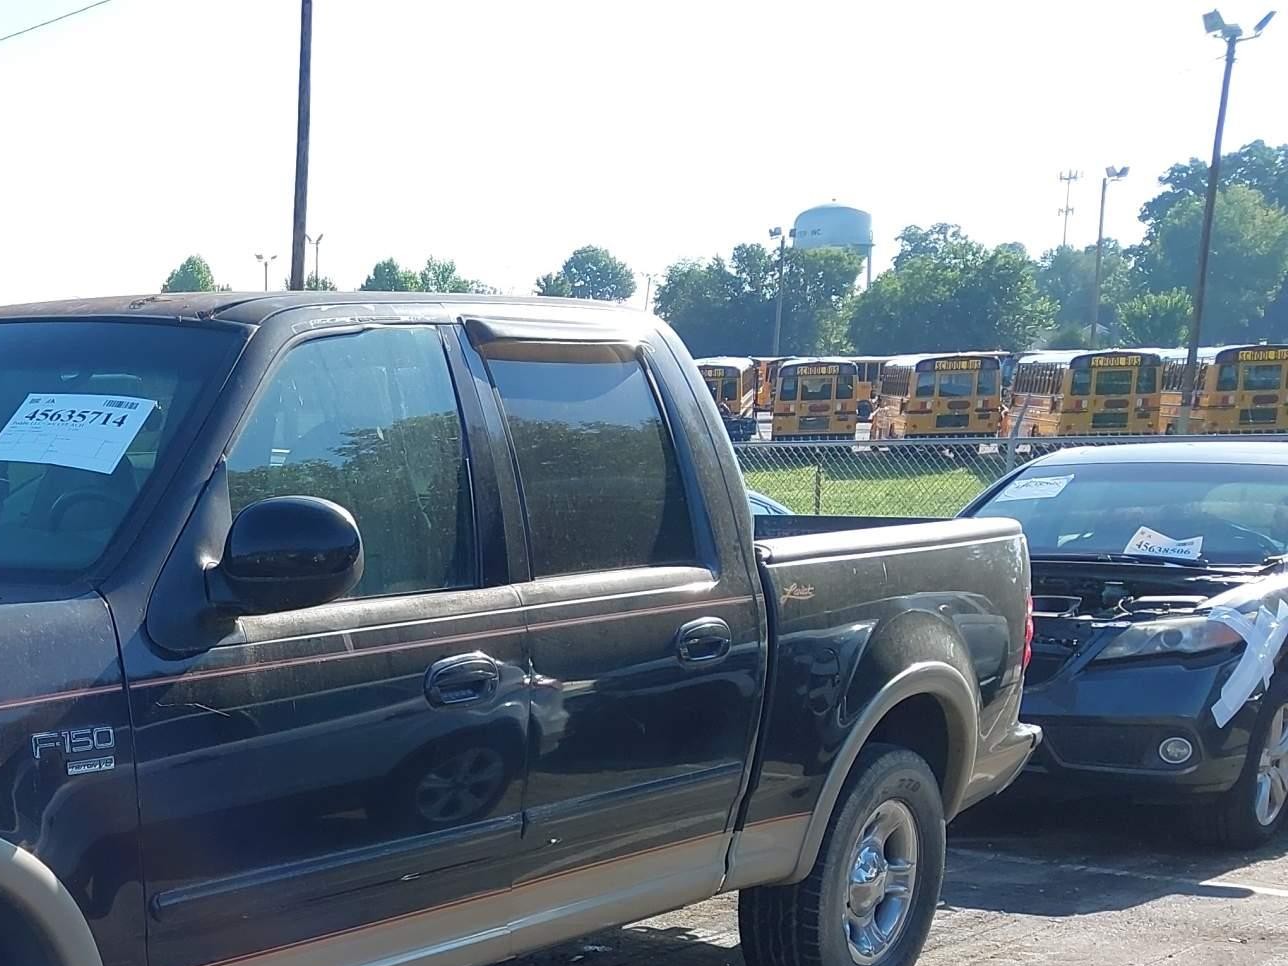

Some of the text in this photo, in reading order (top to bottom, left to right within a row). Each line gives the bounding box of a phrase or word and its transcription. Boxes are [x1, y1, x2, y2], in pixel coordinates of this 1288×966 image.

[935, 360, 981, 370] SCHOOL BUS
[1092, 356, 1141, 366] SCHOOL BUS
[25, 408, 129, 428] 45635714
[32, 727, 115, 759] F-150
